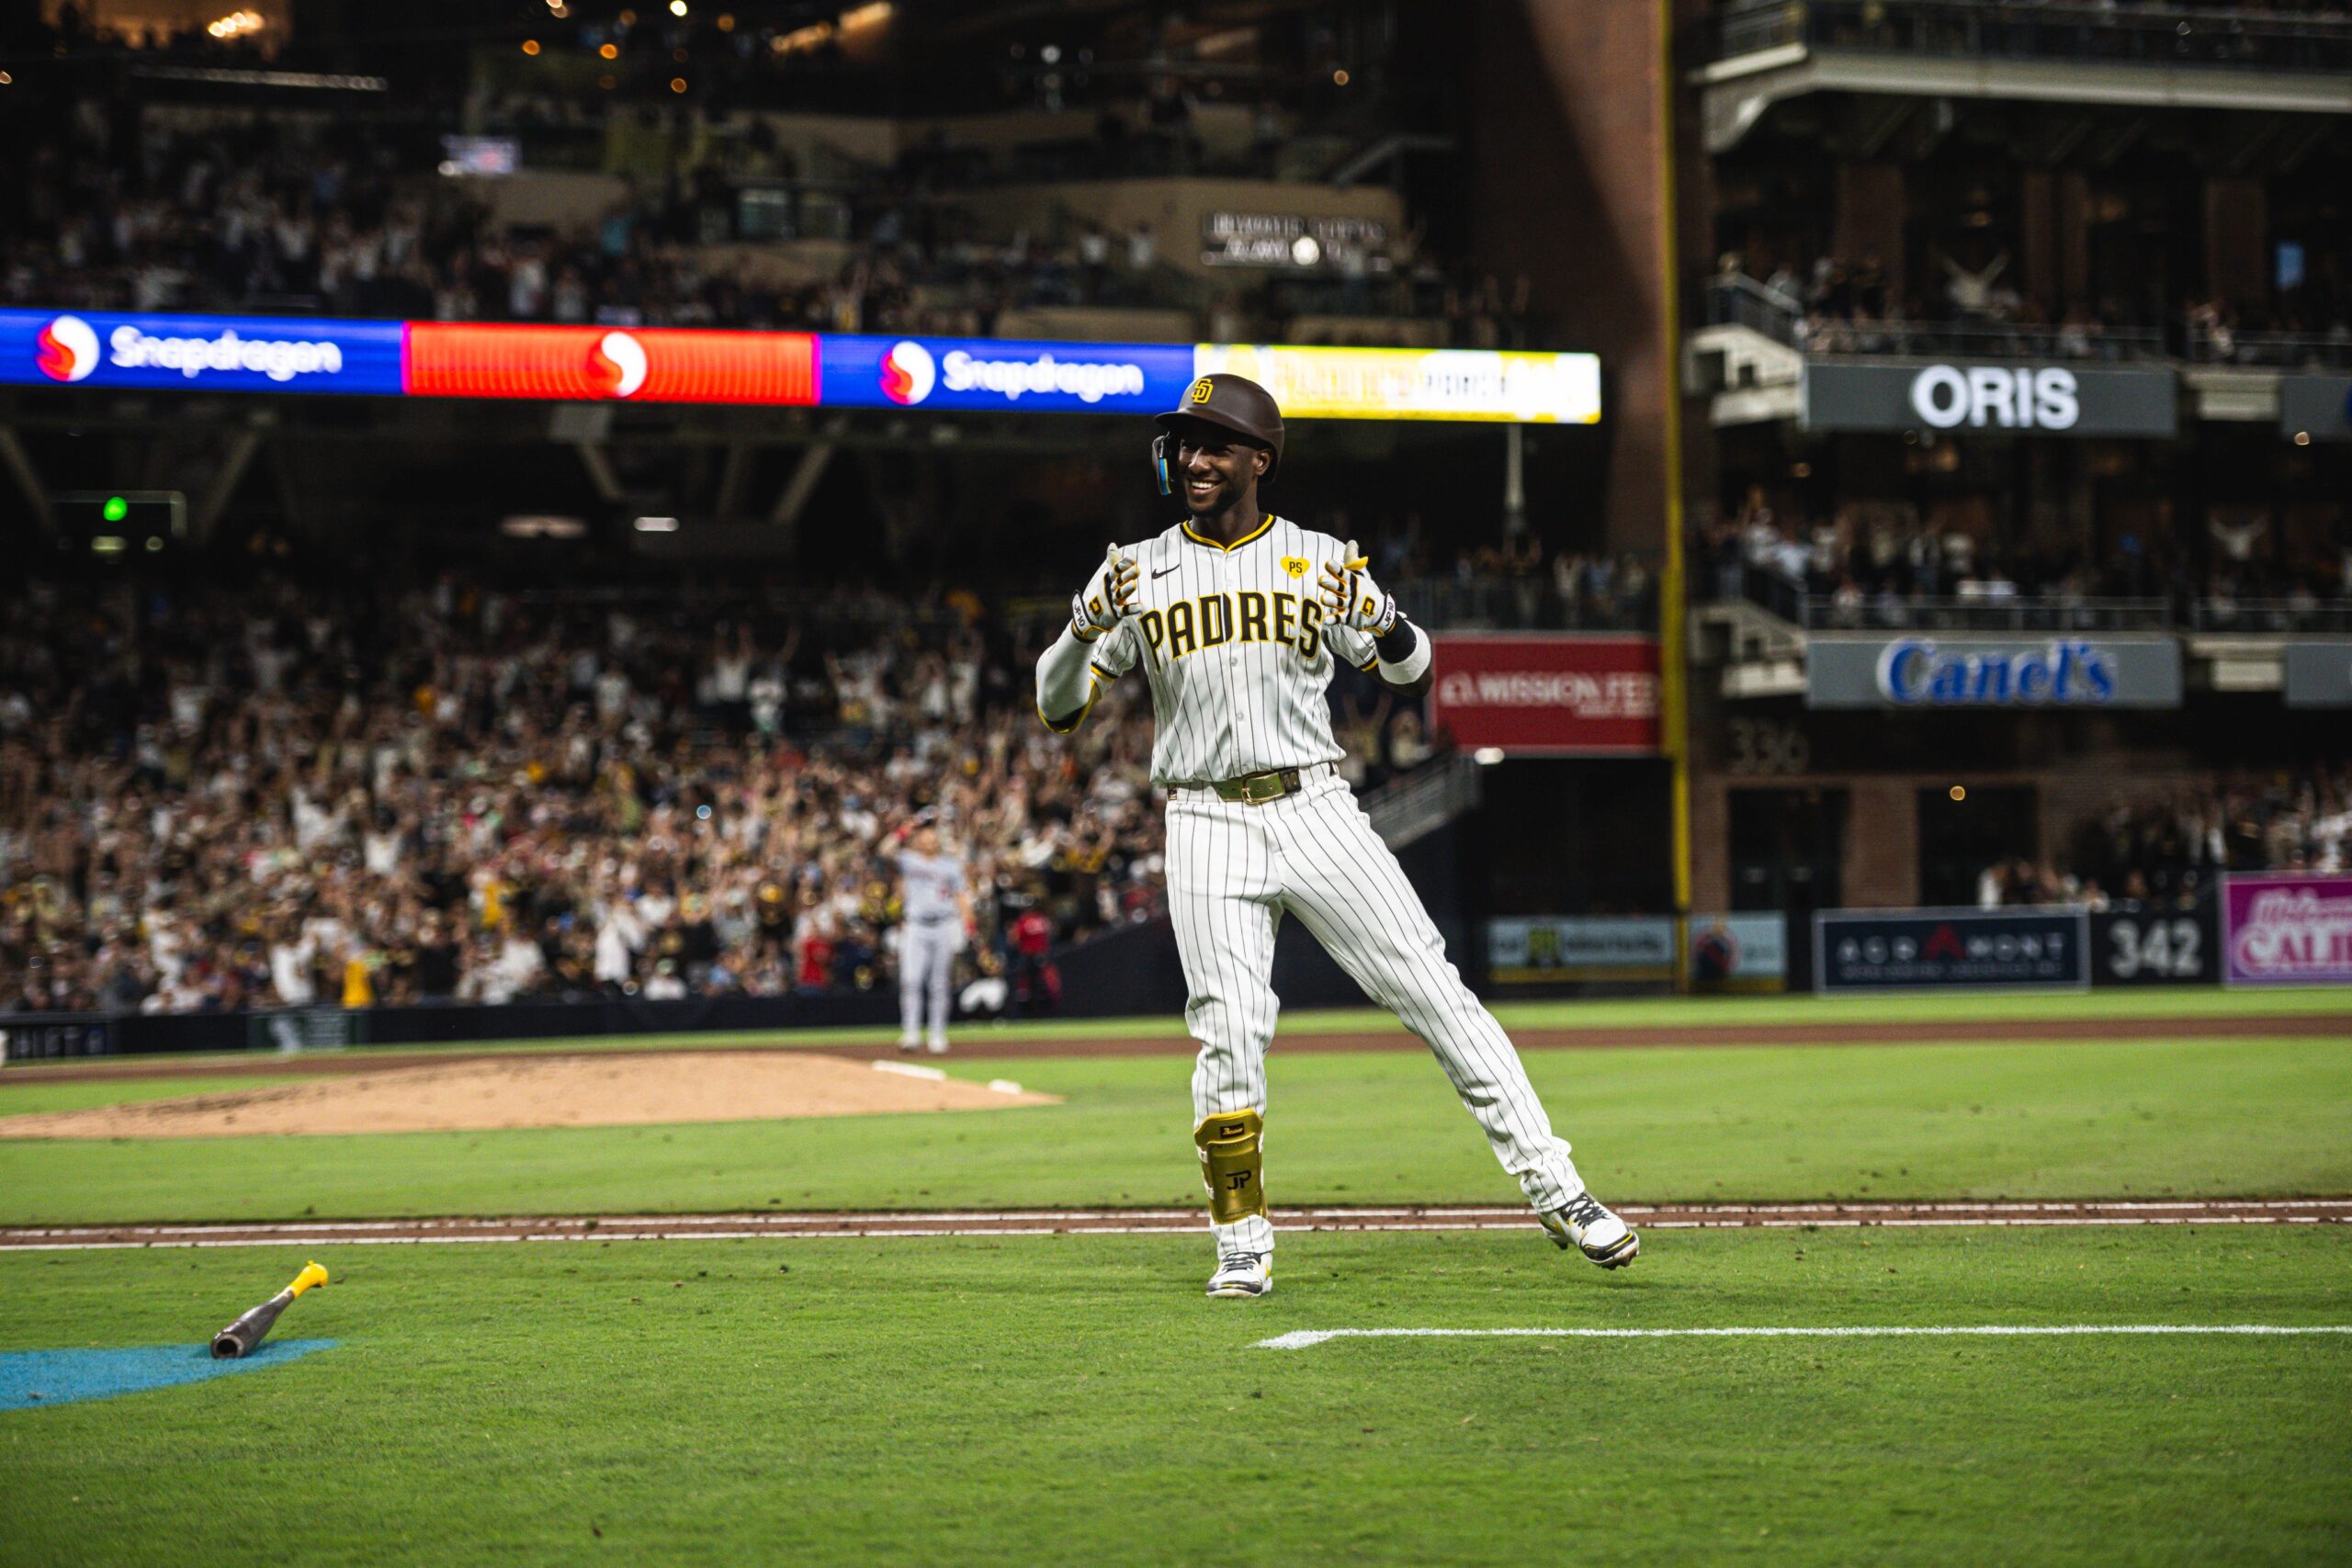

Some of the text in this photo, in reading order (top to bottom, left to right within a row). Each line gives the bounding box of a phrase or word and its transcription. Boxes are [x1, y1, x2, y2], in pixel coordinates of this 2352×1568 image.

[109, 325, 343, 382] Snapdragon
[942, 346, 1145, 403] Snapdragon
[1910, 364, 2080, 430] ORIS
[1288, 561, 1303, 573] PS
[1138, 591, 1324, 676] PADRES
[1476, 670, 1602, 707] MISSION
[1876, 637, 2117, 706] Canel's
[2110, 919, 2203, 978] 342
[1225, 1169, 1251, 1190] JP
